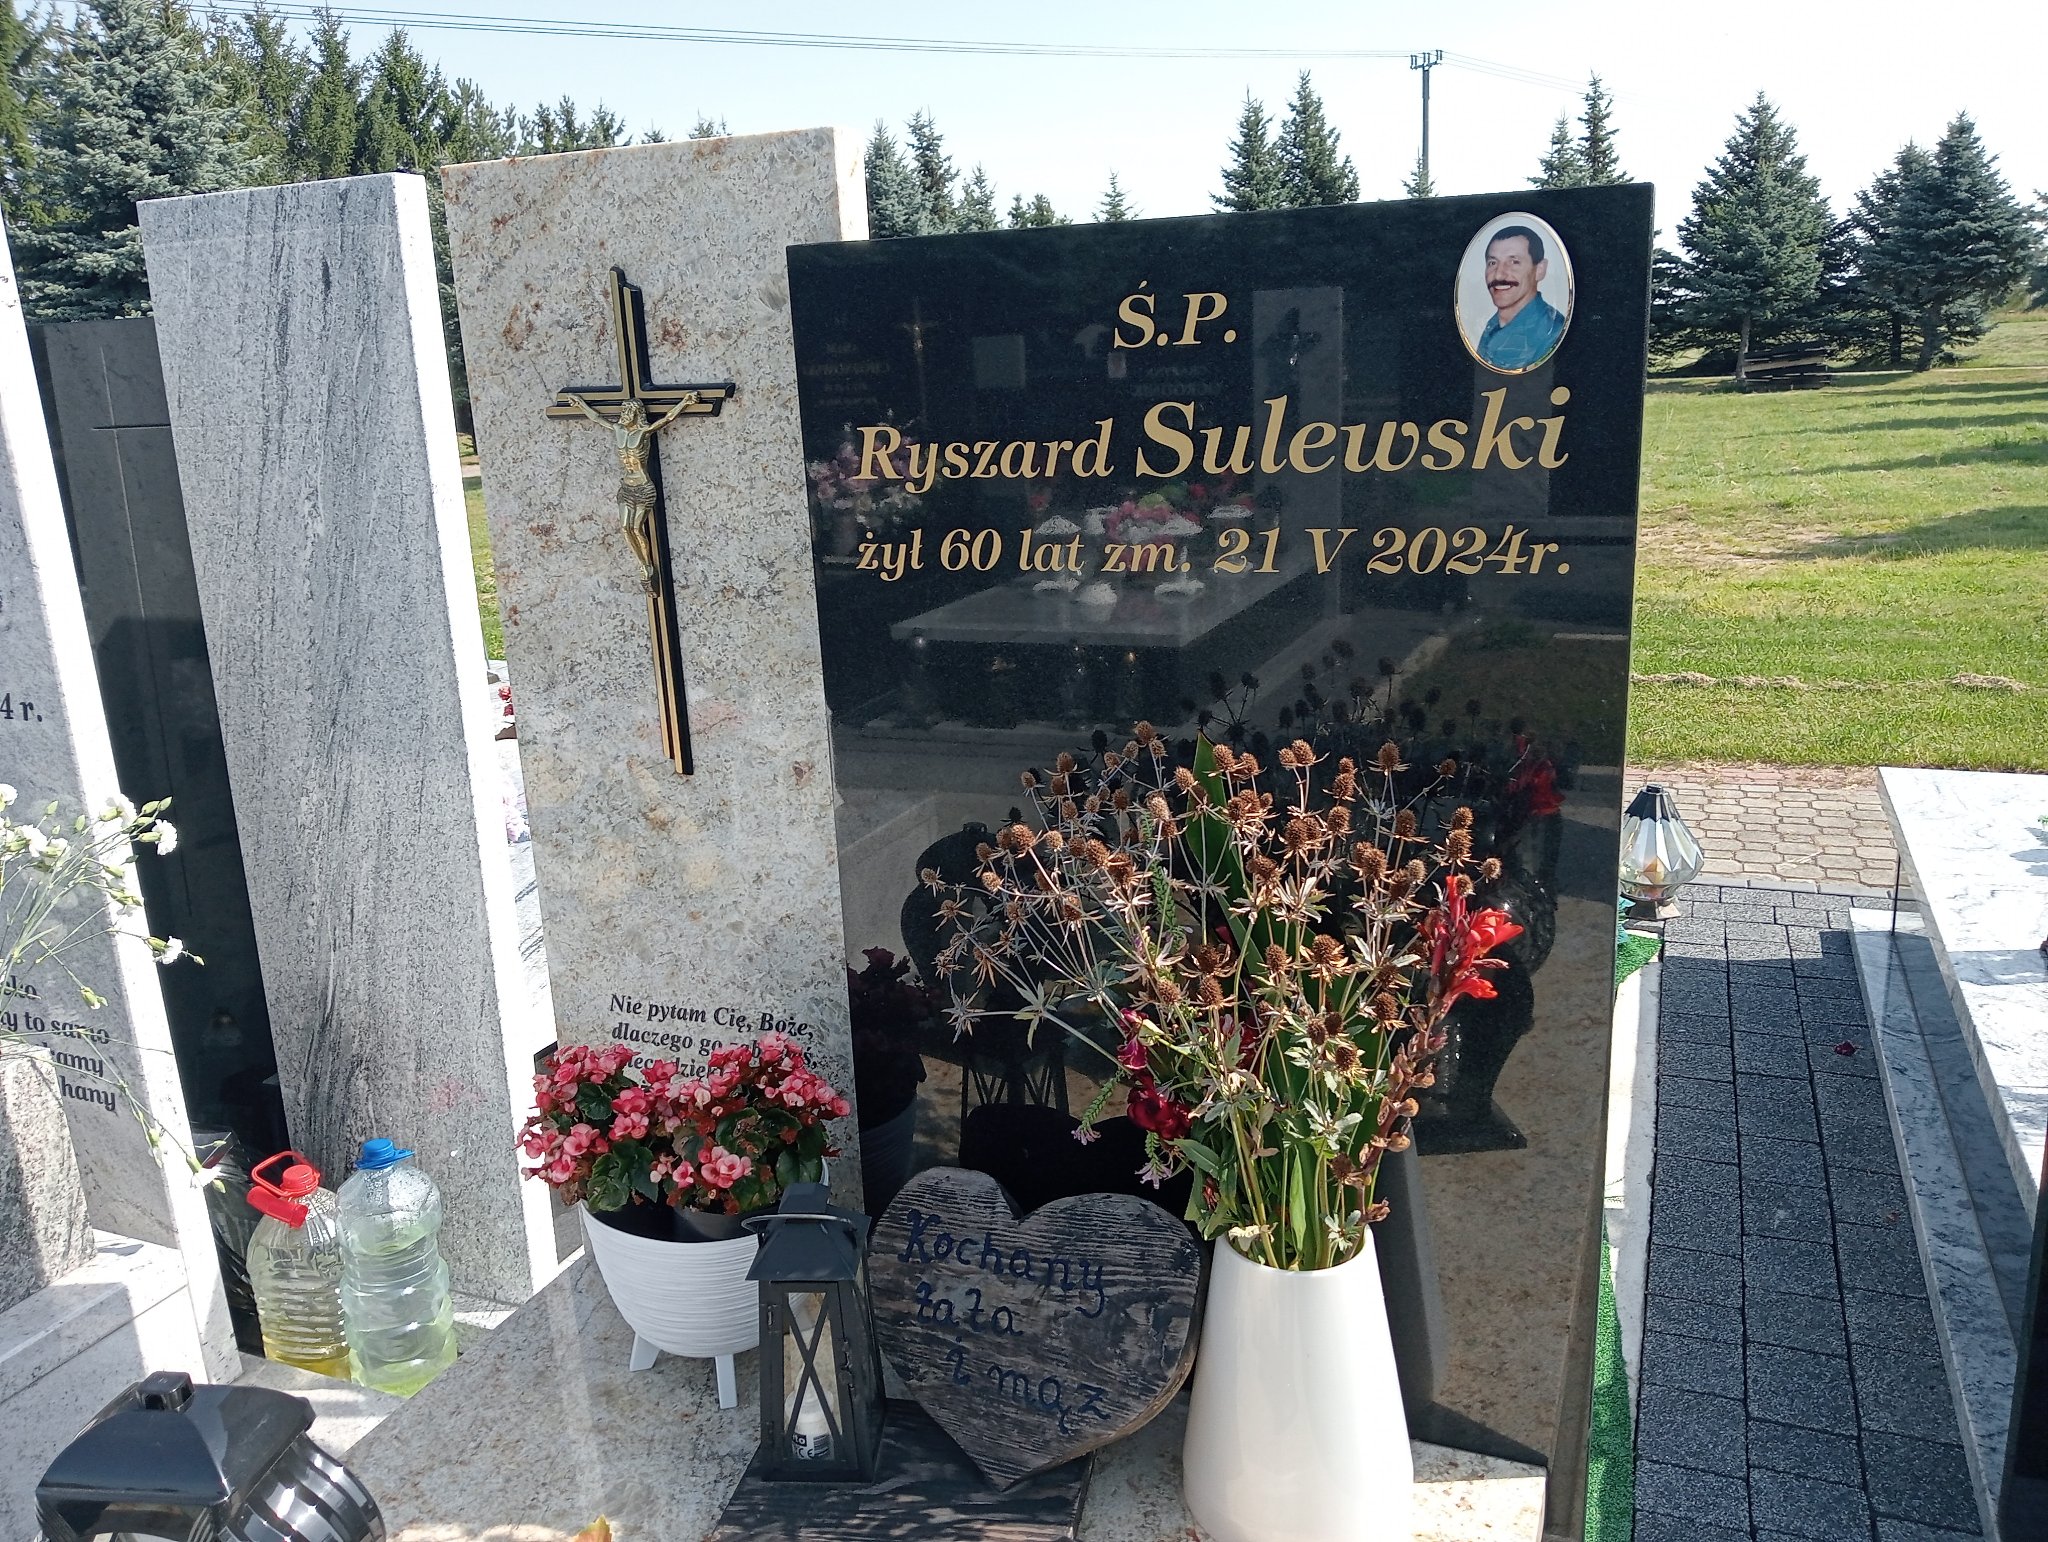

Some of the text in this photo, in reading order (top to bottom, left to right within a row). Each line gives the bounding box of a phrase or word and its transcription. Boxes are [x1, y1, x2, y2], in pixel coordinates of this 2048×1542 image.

[1114, 280, 1237, 349] Ś.P.
[854, 386, 1570, 494] Ryszard Sulewski
[855, 525, 1572, 581] żył 60 lat zm. 21 V 2024r.
[24, 1011, 45, 1032] to
[609, 994, 814, 1039] Nie pytam Cię, Boże,
[611, 1022, 694, 1052] dlaczego
[898, 1208, 1106, 1319] Kochany
[915, 1281, 1025, 1337] tata
